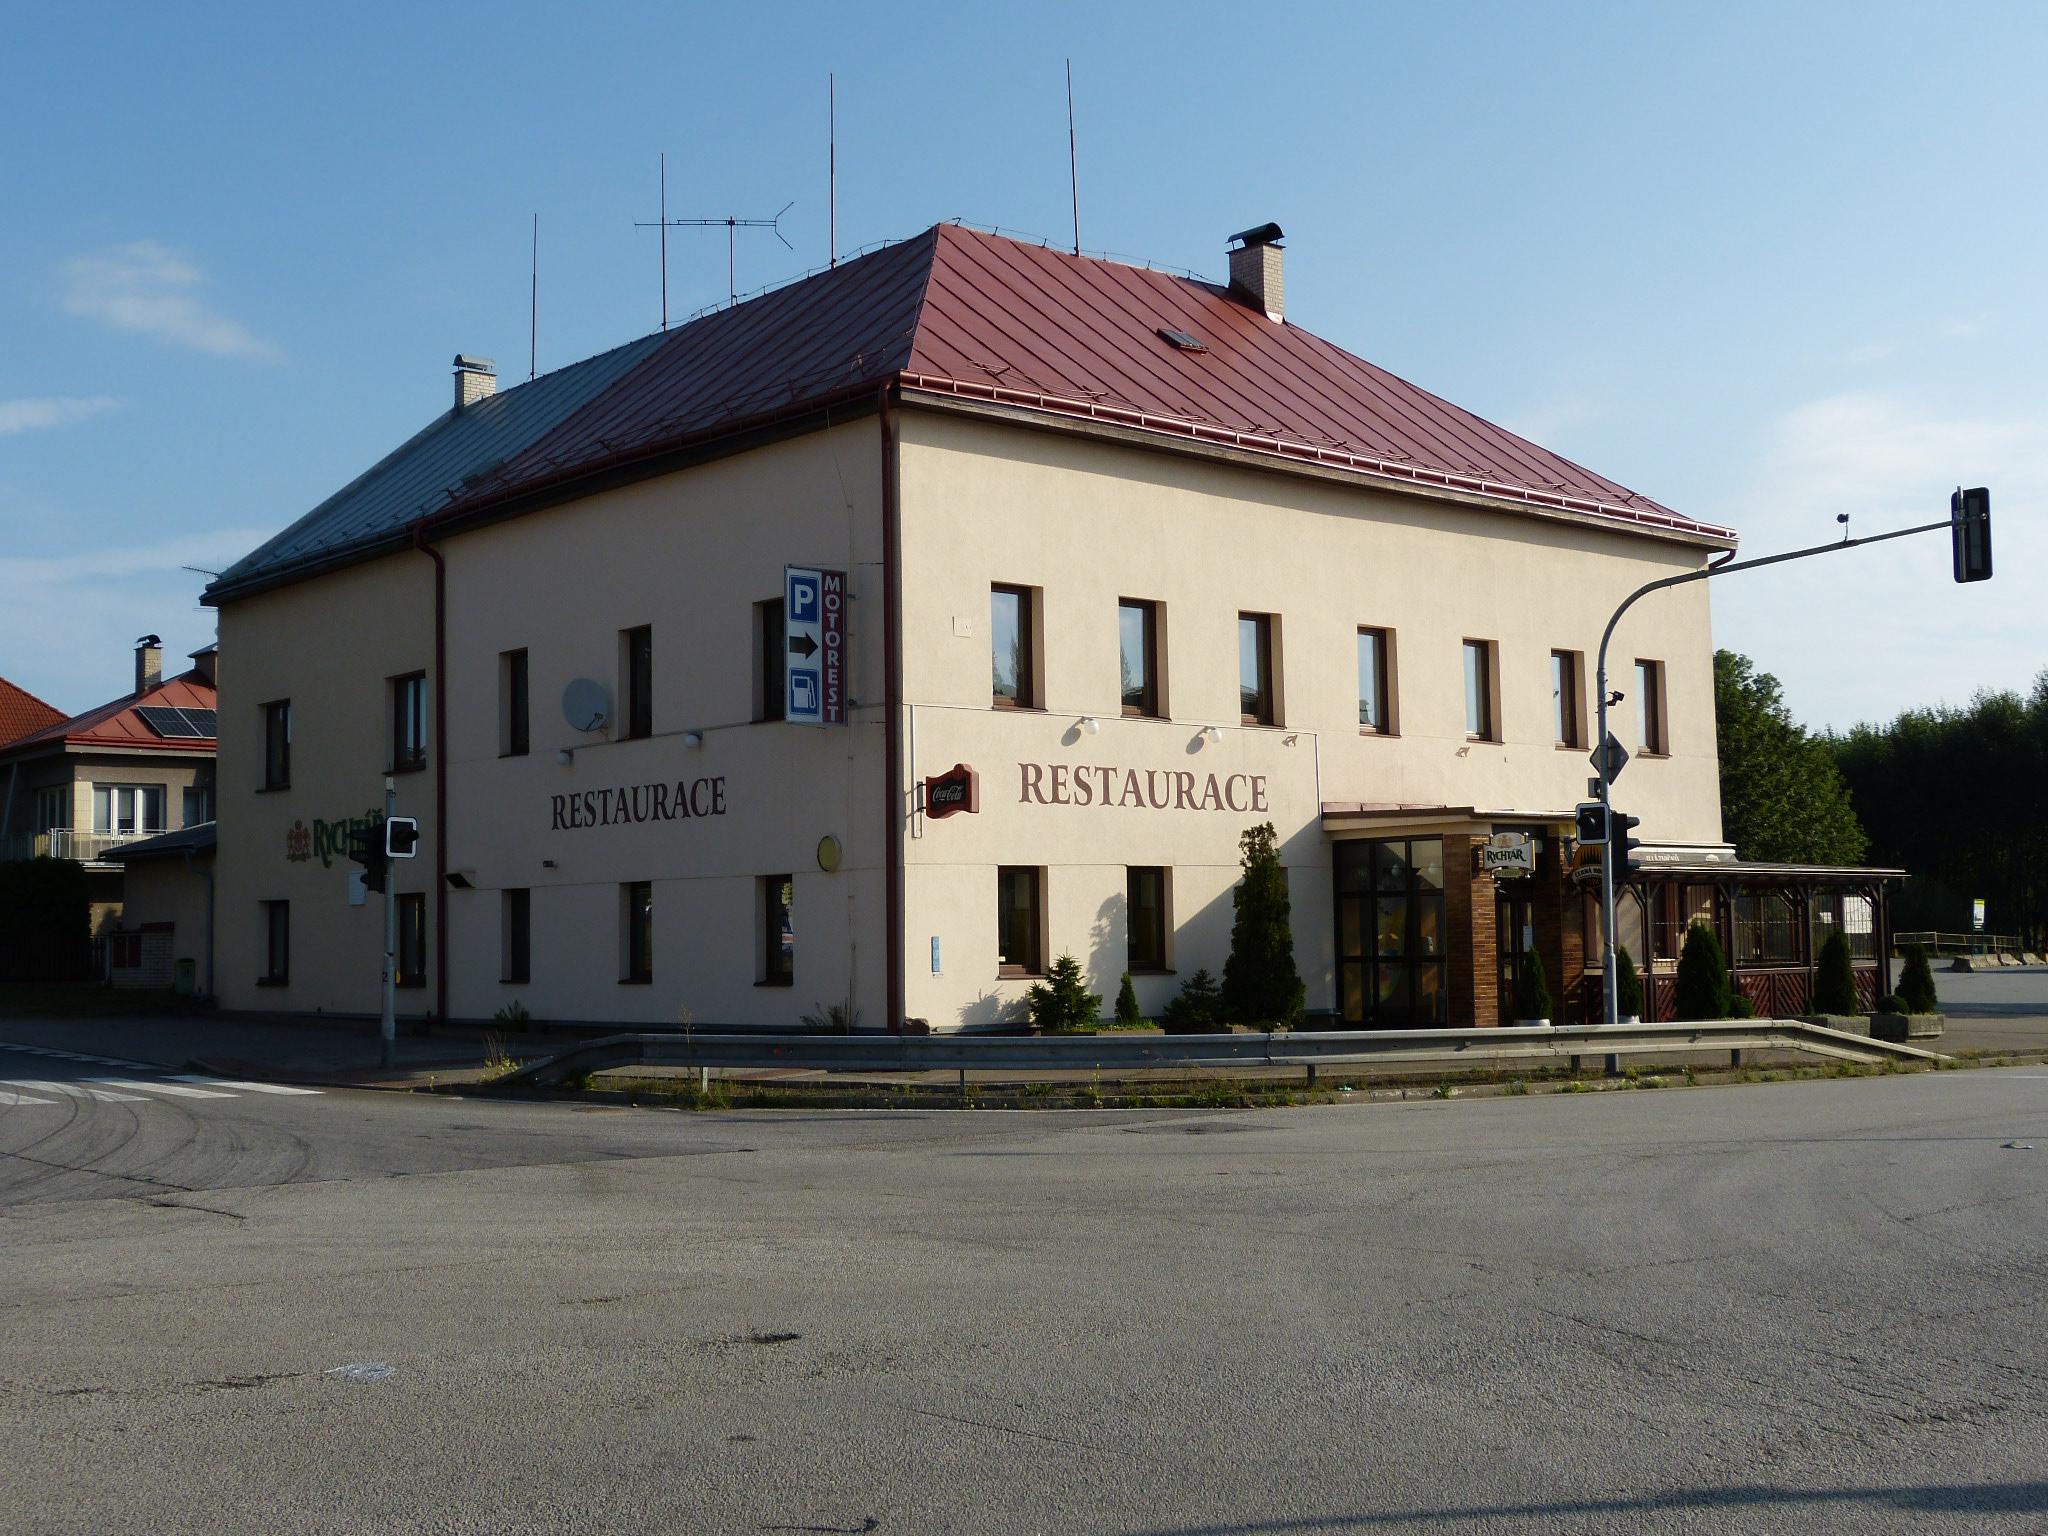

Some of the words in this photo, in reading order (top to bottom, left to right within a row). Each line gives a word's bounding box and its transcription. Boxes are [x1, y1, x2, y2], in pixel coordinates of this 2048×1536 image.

[824, 575, 841, 722] MOTOREST
[551, 776, 727, 831] RESTAURACE
[1017, 762, 1269, 813] RESTAURACE
